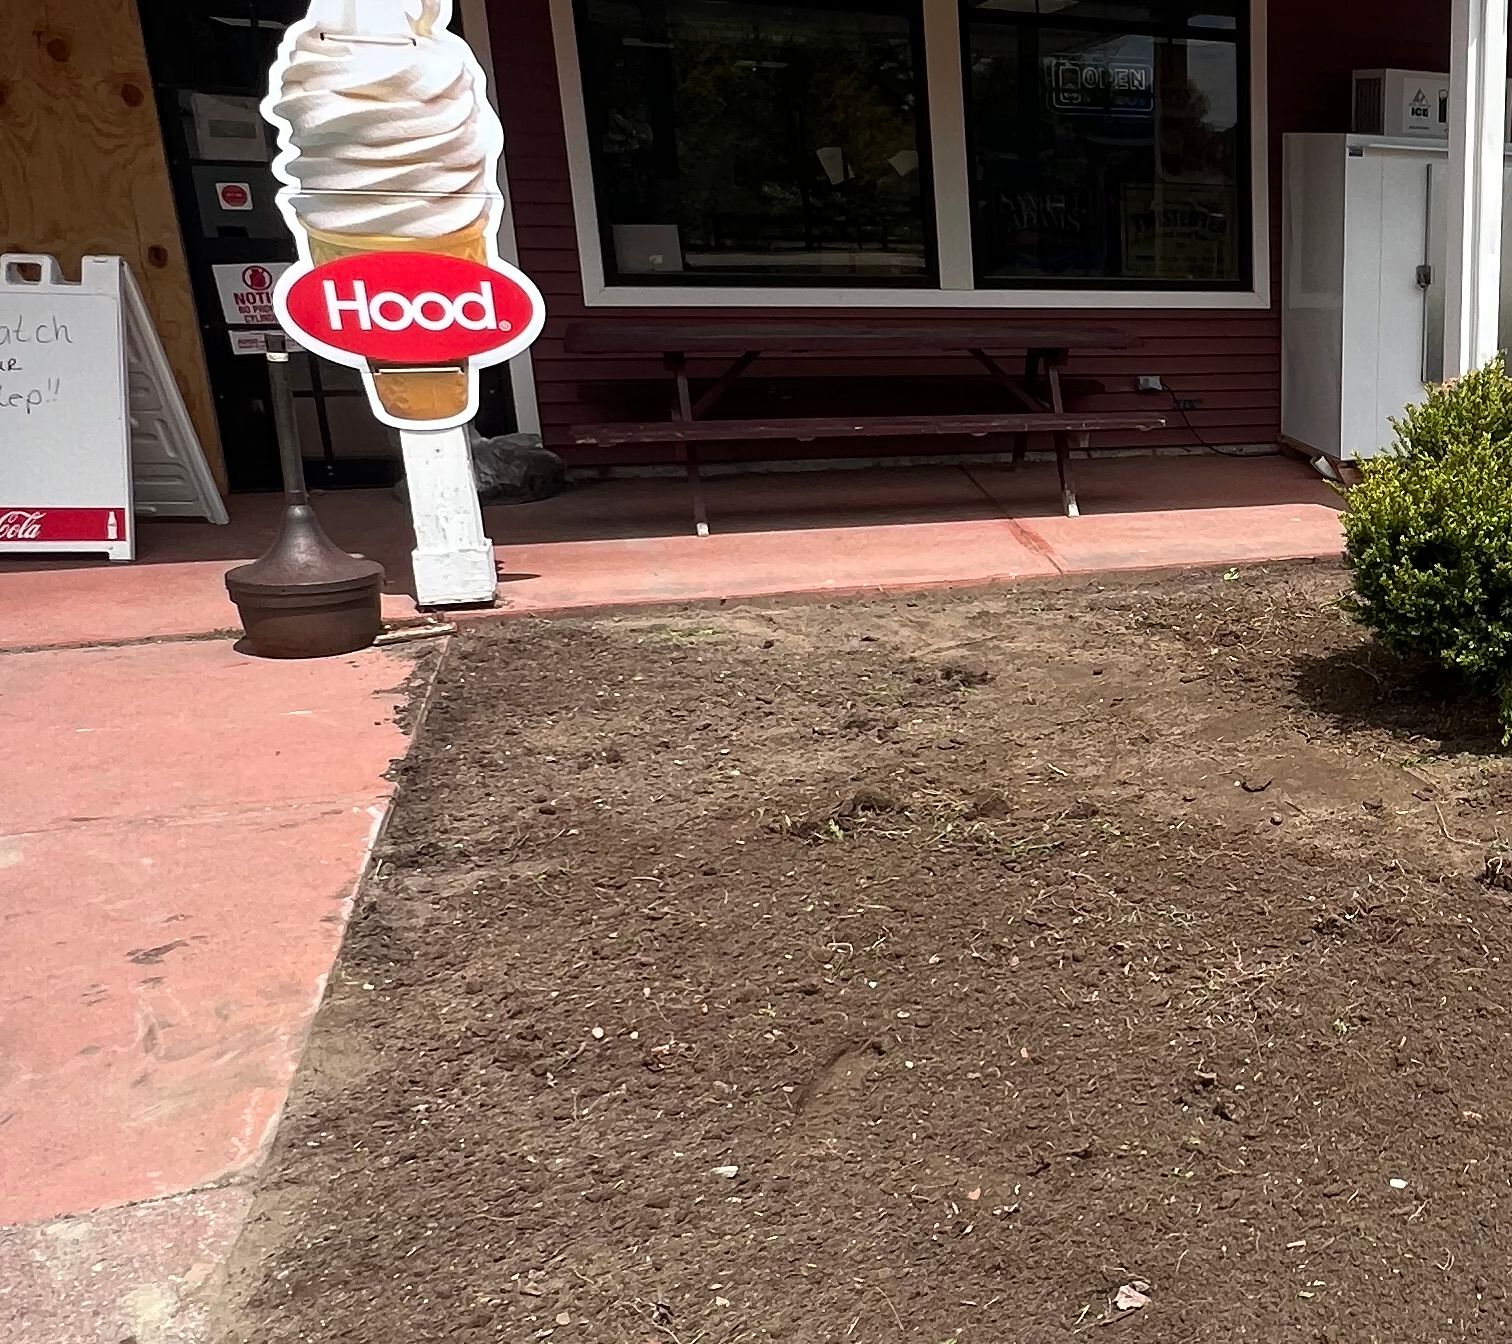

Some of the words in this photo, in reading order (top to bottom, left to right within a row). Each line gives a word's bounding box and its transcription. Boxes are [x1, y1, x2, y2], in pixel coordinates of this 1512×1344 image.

[1411, 107, 1429, 117] ICE
[233, 292, 273, 305] NOTI
[0, 314, 73, 345] atch
